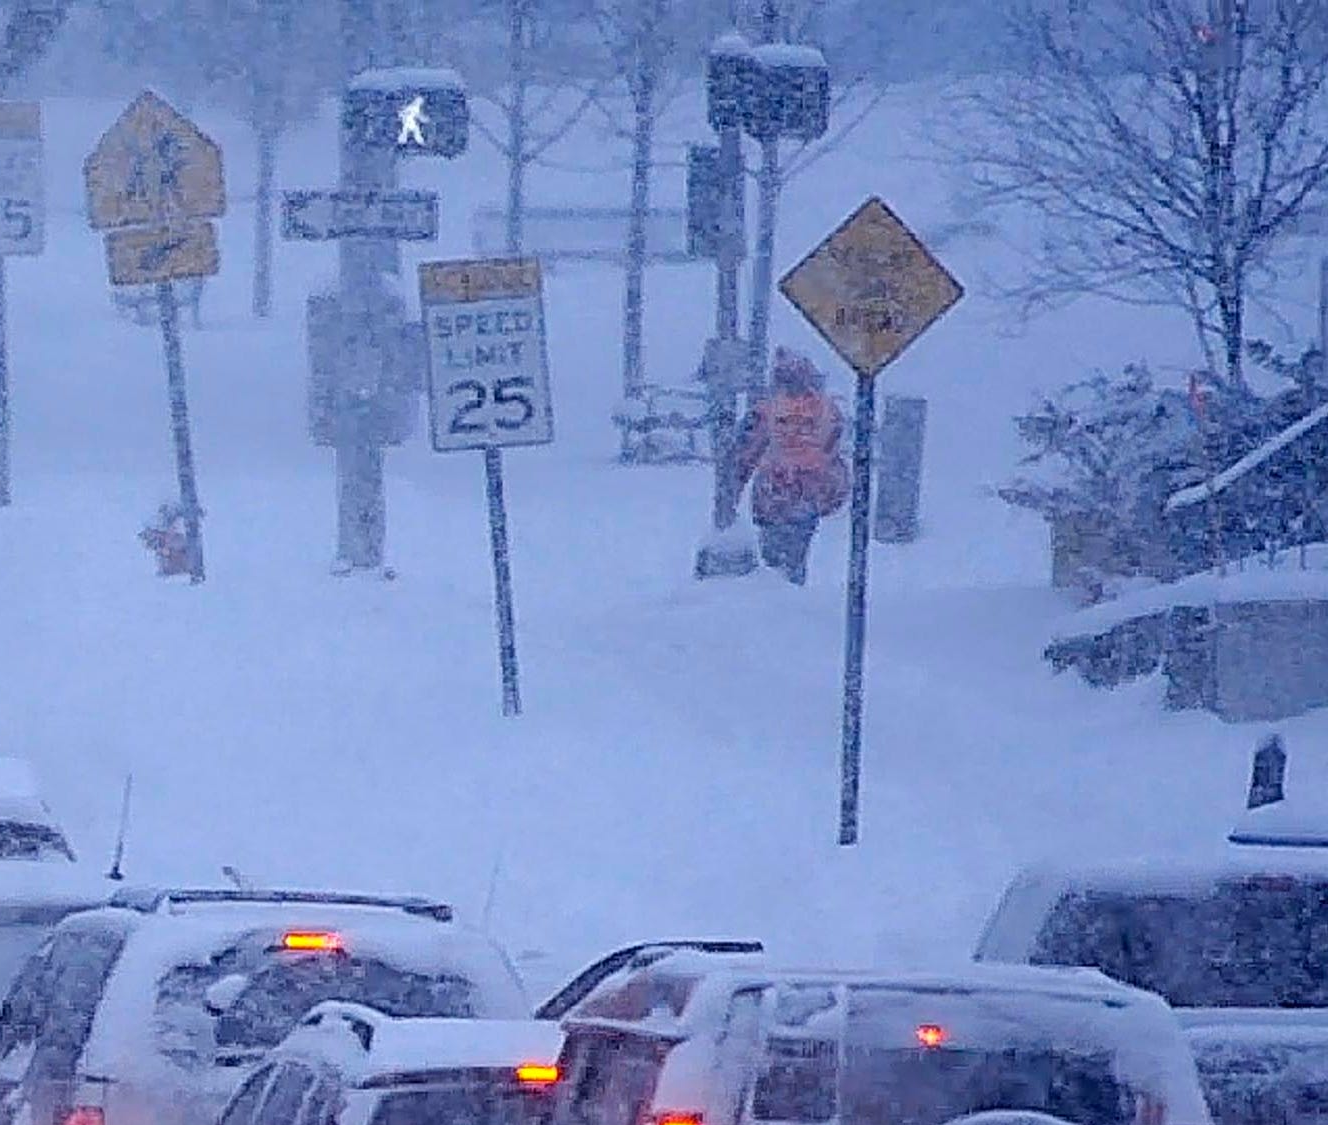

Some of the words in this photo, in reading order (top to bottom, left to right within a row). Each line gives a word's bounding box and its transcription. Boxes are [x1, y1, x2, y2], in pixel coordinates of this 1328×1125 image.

[435, 311, 533, 337] SPEED
[447, 341, 524, 367] LIMIT
[447, 376, 534, 433] 25
